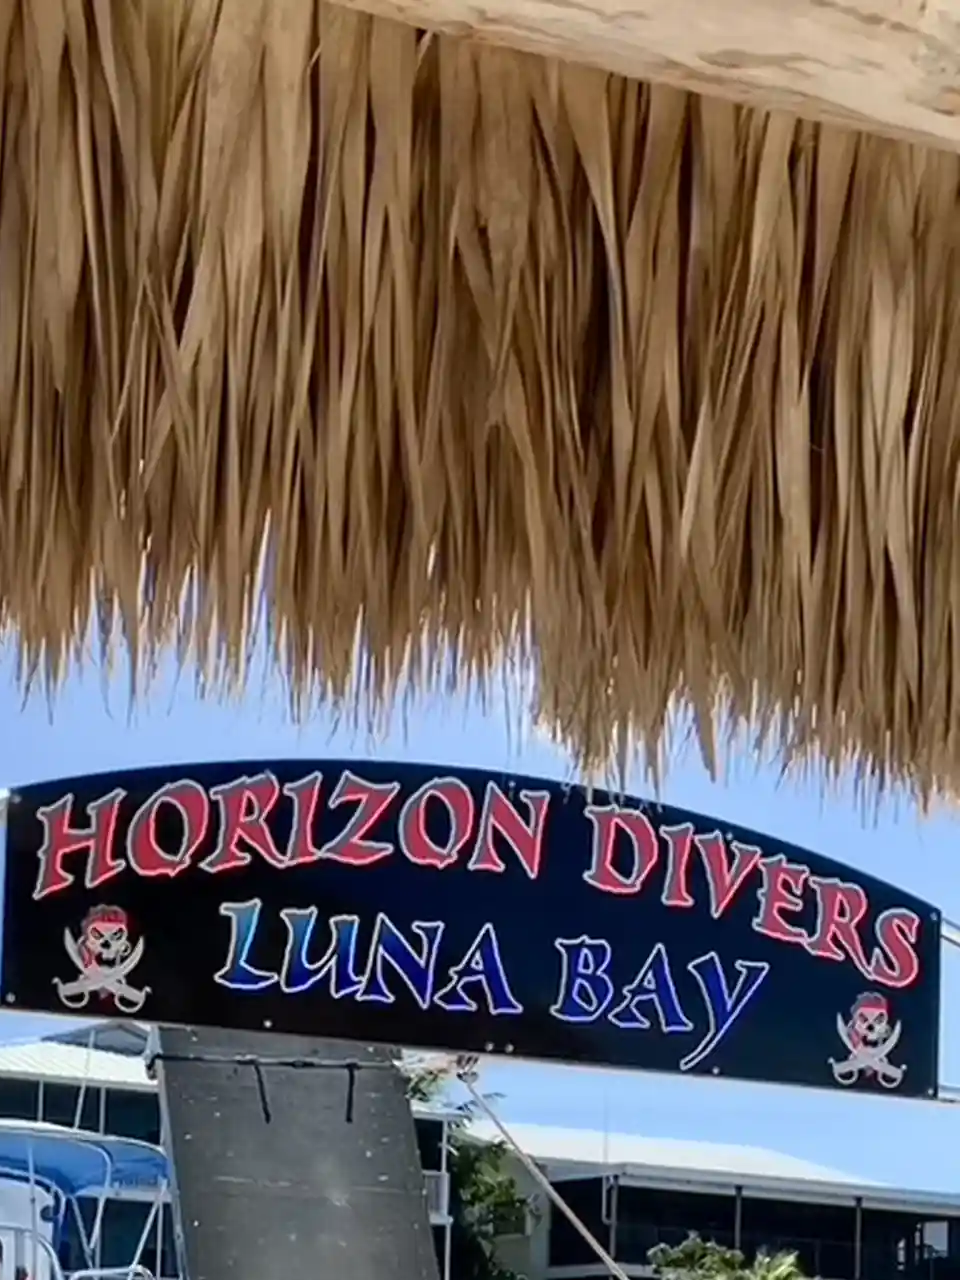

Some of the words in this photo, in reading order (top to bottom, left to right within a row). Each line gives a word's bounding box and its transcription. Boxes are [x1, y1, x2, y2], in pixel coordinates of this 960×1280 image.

[32, 770, 550, 900] HORIZON
[582, 803, 920, 987] DIVERS
[213, 897, 523, 1015] LUNA
[549, 934, 770, 1071] BAY
